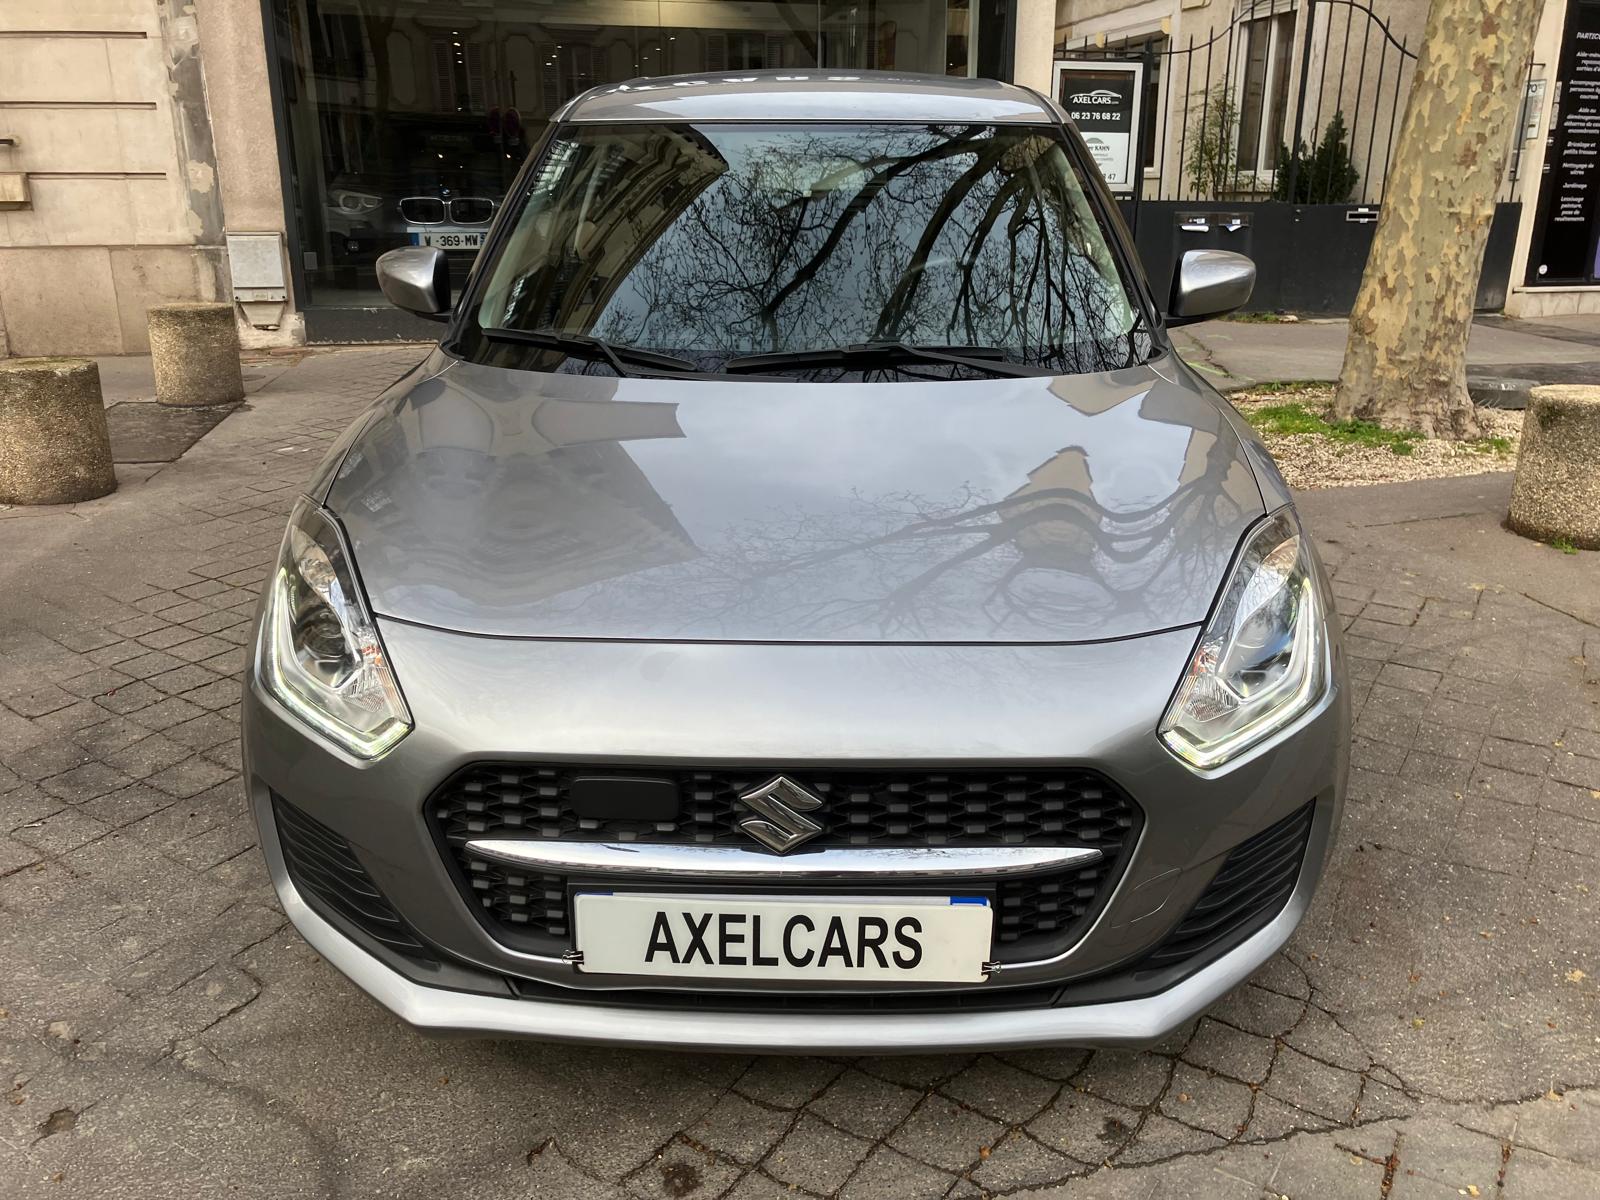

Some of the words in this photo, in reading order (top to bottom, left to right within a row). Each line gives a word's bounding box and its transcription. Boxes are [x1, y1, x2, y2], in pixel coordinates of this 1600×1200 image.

[1071, 112, 1080, 120] 06
[1081, 112, 1090, 120] 23
[1112, 112, 1121, 120] 22
[644, 911, 923, 970] AXELCARS
